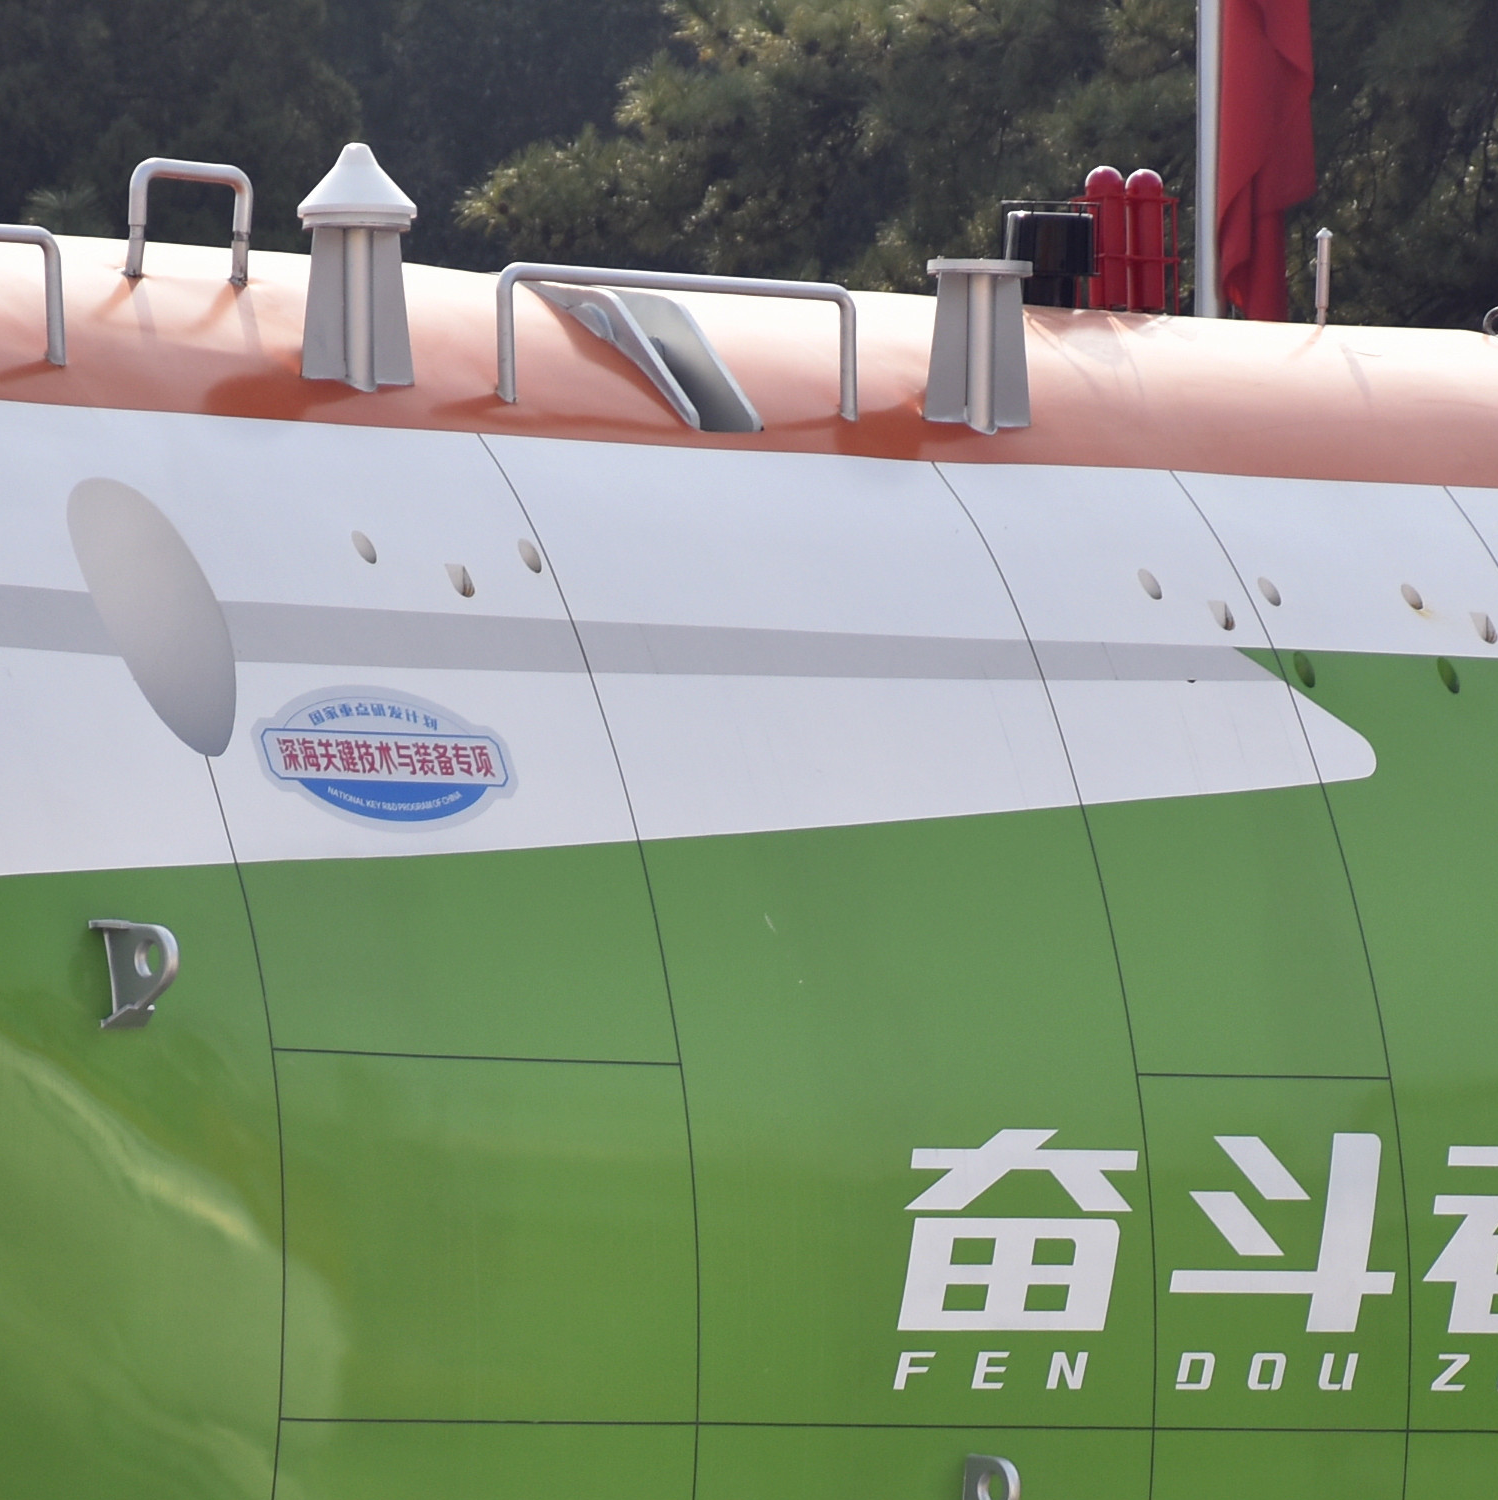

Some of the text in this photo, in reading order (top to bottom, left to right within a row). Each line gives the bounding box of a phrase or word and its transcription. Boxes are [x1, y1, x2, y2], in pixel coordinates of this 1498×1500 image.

[308, 701, 439, 731] 国家重点研发计划
[275, 736, 497, 779] 深海关键技术与装备专项
[327, 785, 365, 807] NATIONAL
[365, 799, 381, 810] KEY
[397, 799, 432, 812] PROGRAM
[441, 790, 463, 806] CHINA
[892, 1350, 1091, 1391] FEN
[1174, 1351, 1360, 1392] DOU
